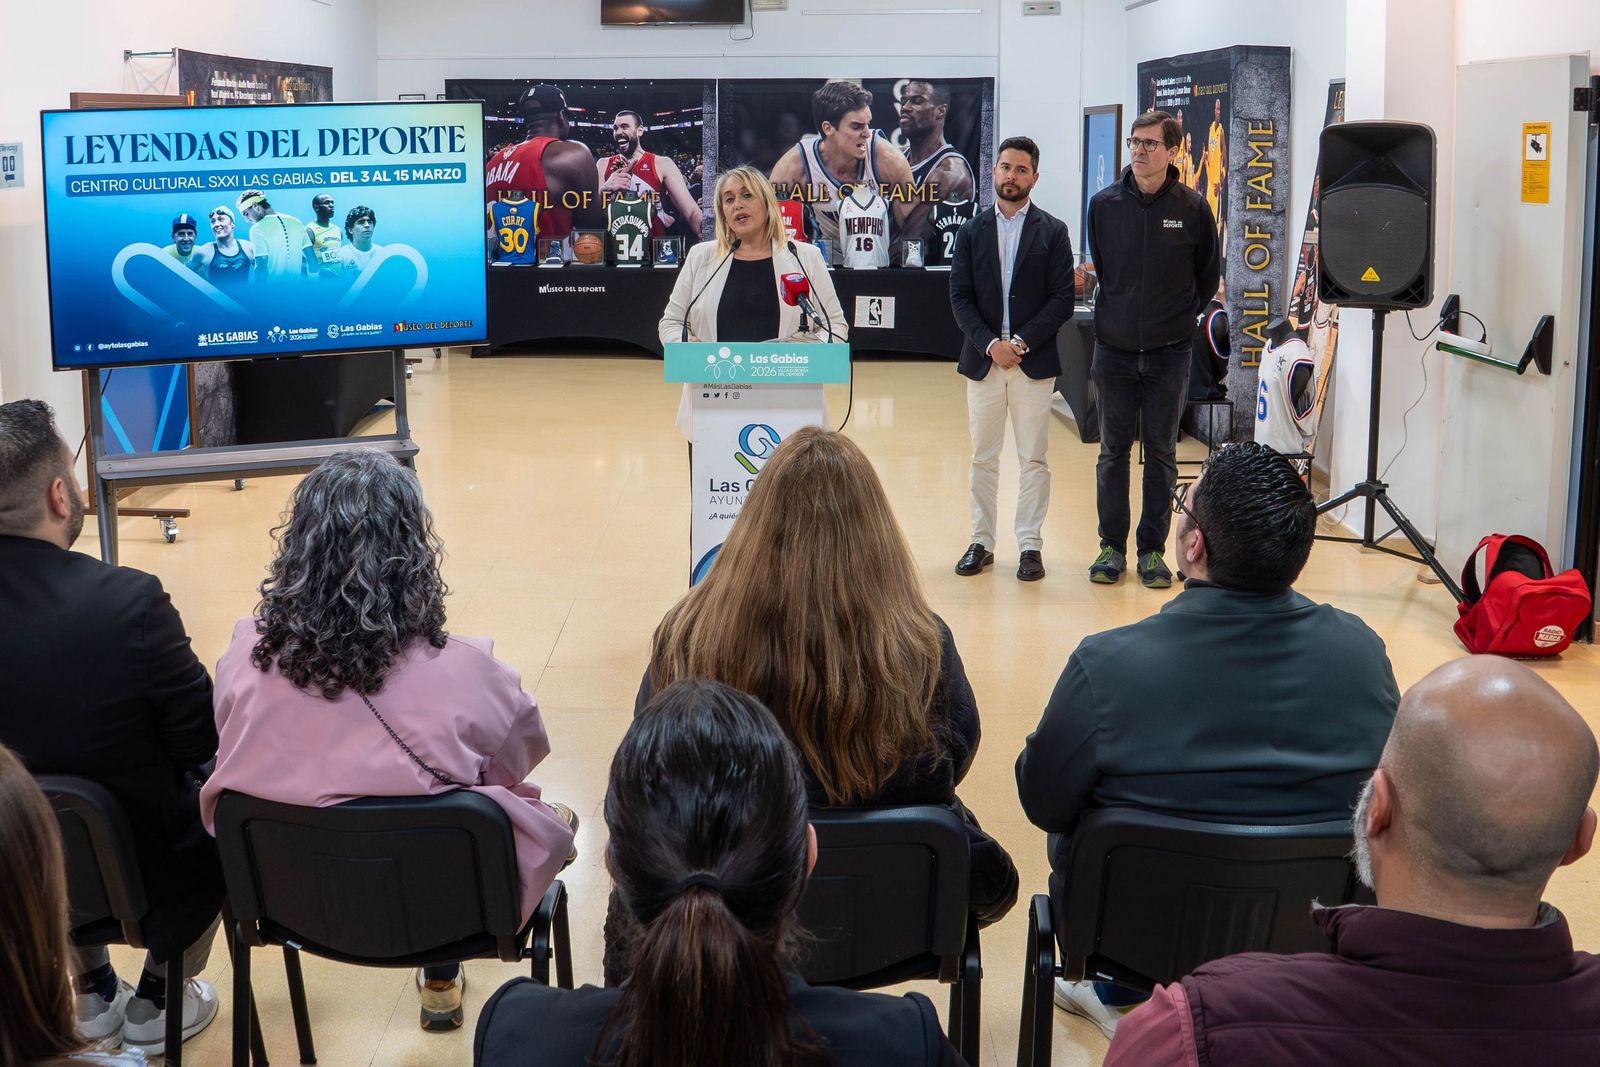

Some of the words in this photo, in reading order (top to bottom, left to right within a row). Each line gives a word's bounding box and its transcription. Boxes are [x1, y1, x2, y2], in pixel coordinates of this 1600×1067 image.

[64, 130, 238, 165] LEYENDAS
[246, 129, 309, 159] DEL
[317, 125, 466, 157] DEPORTE
[1246, 120, 1273, 210] FAME
[71, 179, 129, 193] CENTRO
[132, 176, 205, 191] CULTURAL
[208, 175, 238, 188] SXXI
[243, 174, 269, 187] LAS
[273, 172, 326, 186] GABIAS,
[330, 171, 358, 184] DEL
[360, 170, 370, 183] 3
[372, 170, 391, 182] AL
[393, 169, 409, 182] 15
[412, 167, 462, 181] MARZO
[562, 190, 592, 209] OF
[879, 183, 940, 202] FAME
[501, 215, 525, 227] CURRY
[845, 217, 884, 237] MEMPHIS
[499, 228, 529, 253] 30
[616, 234, 644, 261] 34
[855, 237, 873, 252] 16
[1244, 225, 1272, 271] OF
[539, 284, 563, 293] MUSEO
[355, 323, 383, 331] Gabias
[1241, 283, 1270, 367] HALL
[98, 341, 149, 350] @aytolasgabias
[208, 333, 224, 343] LAS
[226, 331, 258, 341] GABIAS
[750, 354, 768, 364] Las
[770, 354, 809, 364] Gabias
[751, 366, 777, 377] 2026
[709, 478, 740, 493] Las
[719, 512, 738, 520] quié
